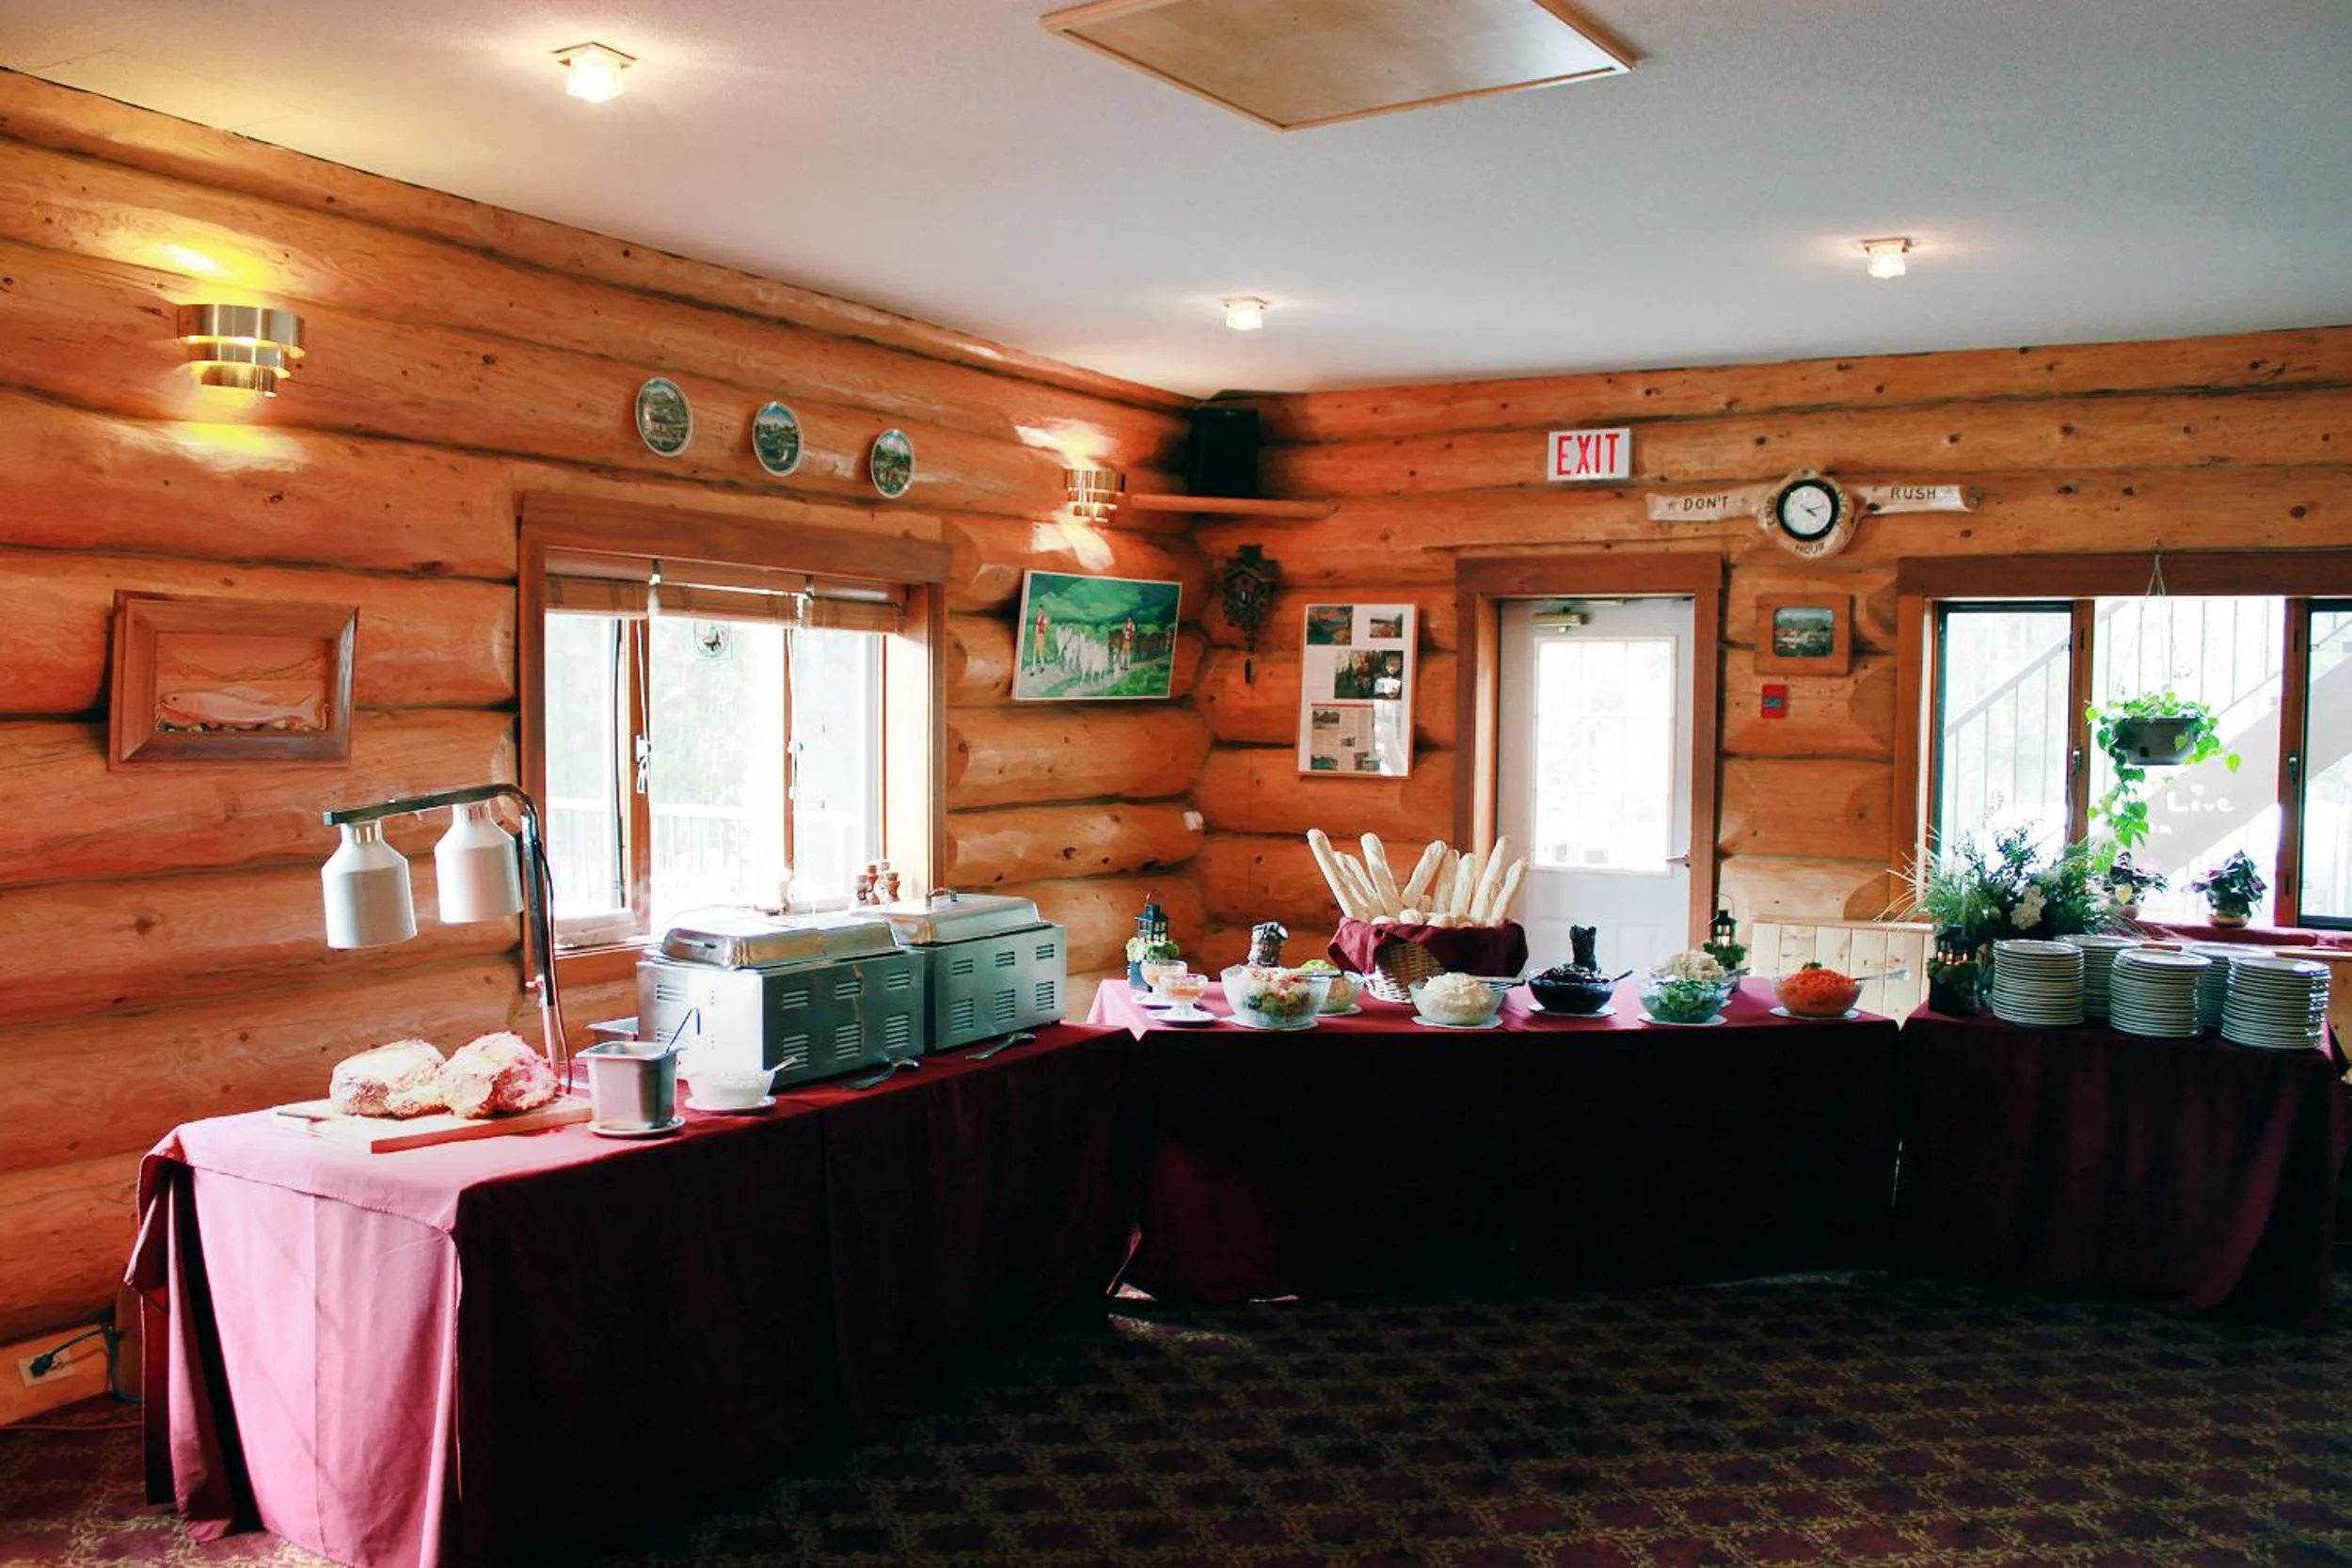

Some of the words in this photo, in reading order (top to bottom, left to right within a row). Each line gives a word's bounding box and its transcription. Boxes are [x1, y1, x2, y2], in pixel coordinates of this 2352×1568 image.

[1556, 434, 1620, 476] EXIT
[1683, 496, 1729, 512] DON'T
[1890, 486, 1936, 500] RUSH
